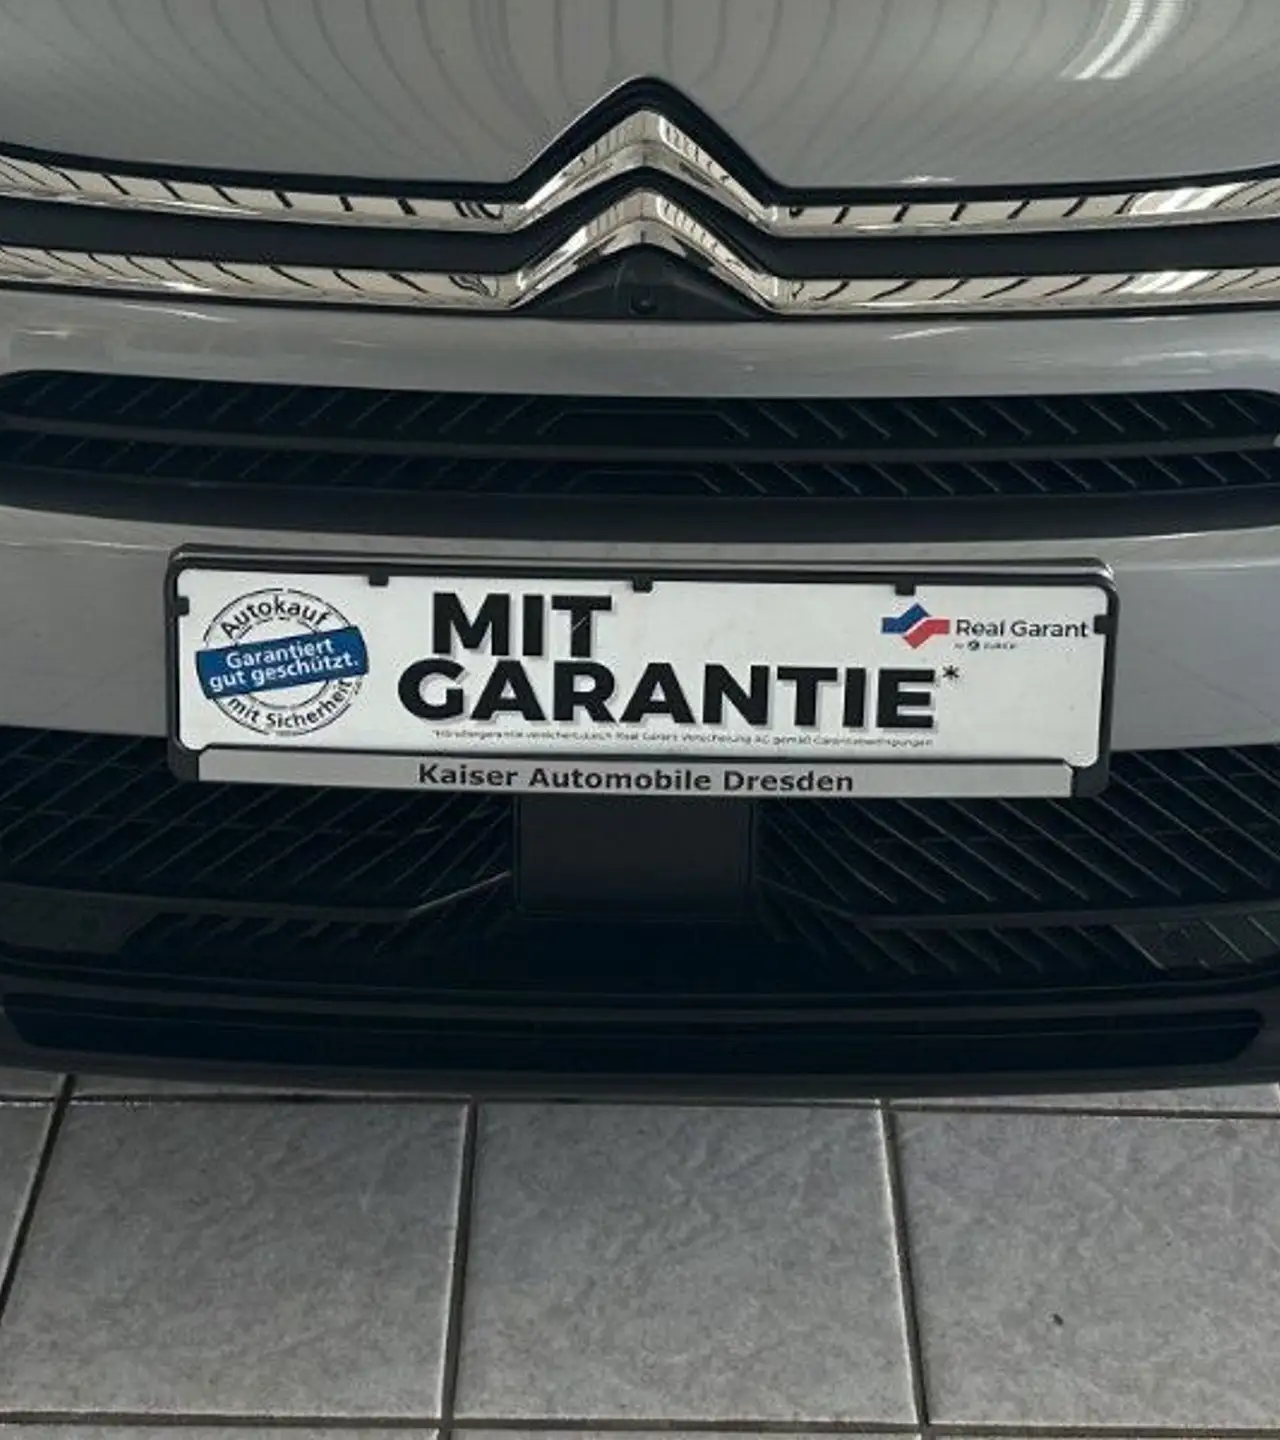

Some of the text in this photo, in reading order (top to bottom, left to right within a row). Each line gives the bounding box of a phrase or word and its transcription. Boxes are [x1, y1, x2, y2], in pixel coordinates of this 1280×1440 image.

[220, 596, 333, 639] Autokauf
[433, 591, 613, 658] MIT
[956, 618, 1088, 638] Real Garant
[226, 638, 334, 669] Garantiert
[209, 651, 359, 692] gut geschützt.
[227, 698, 261, 724] mit
[419, 763, 853, 792] Kaiser Automobile Dresden
